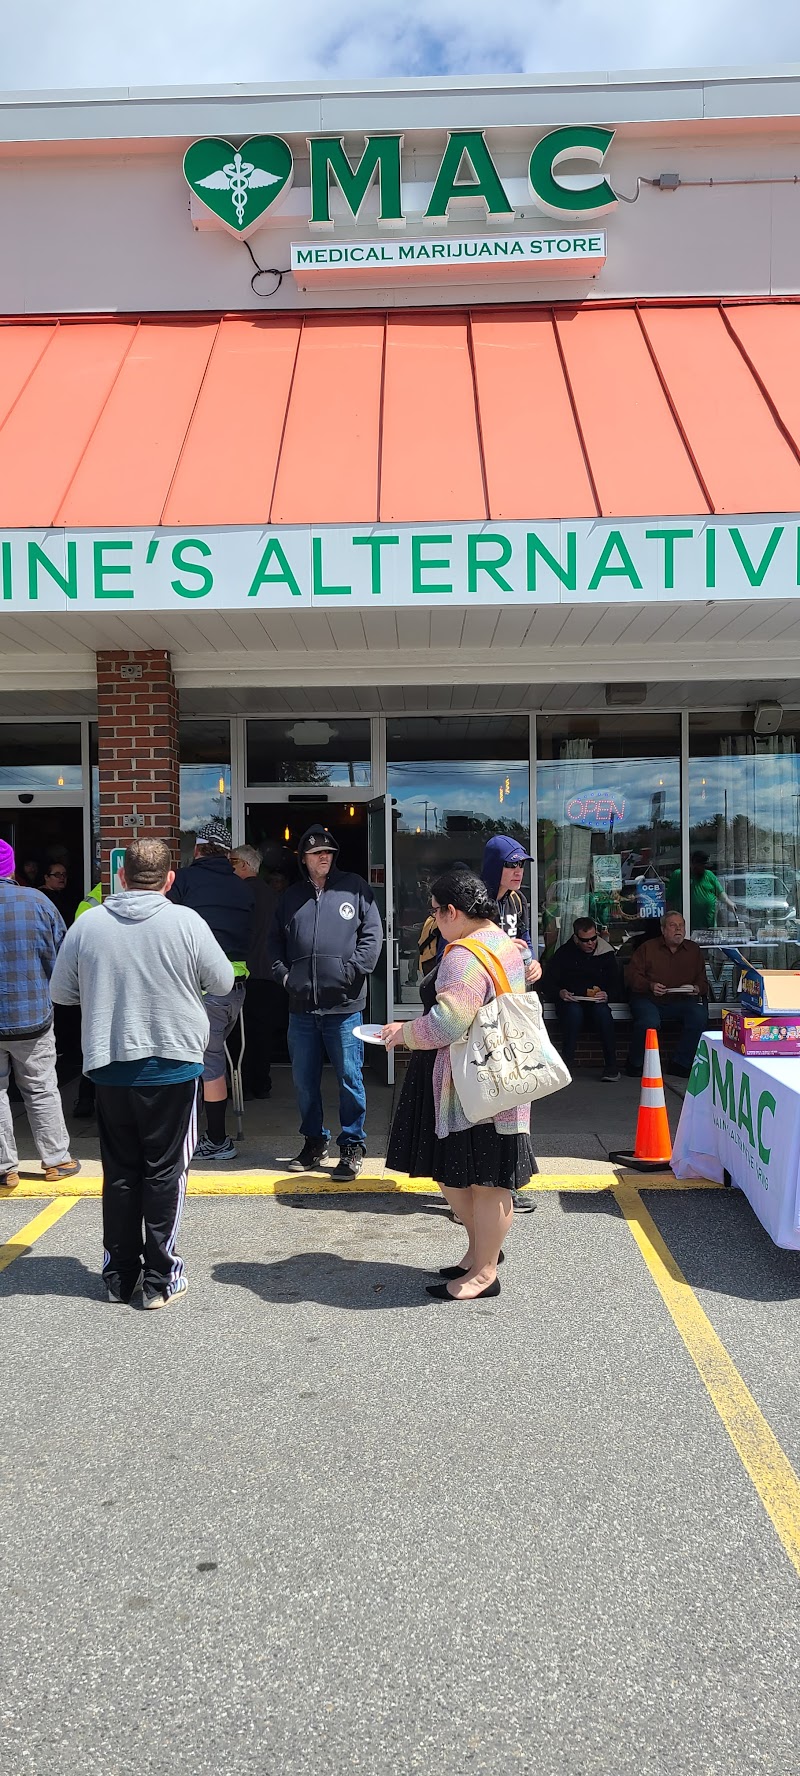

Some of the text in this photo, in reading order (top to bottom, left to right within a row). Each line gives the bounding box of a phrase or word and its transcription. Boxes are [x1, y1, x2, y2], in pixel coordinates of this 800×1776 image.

[305, 125, 619, 228] MAC
[296, 237, 602, 264] MEDICAL MARIJUANA STORE
[247, 526, 800, 597] ALTERNATIV
[567, 799, 626, 821] OPEN
[639, 906, 665, 918] OPEN
[711, 1047, 777, 1166] MAC
